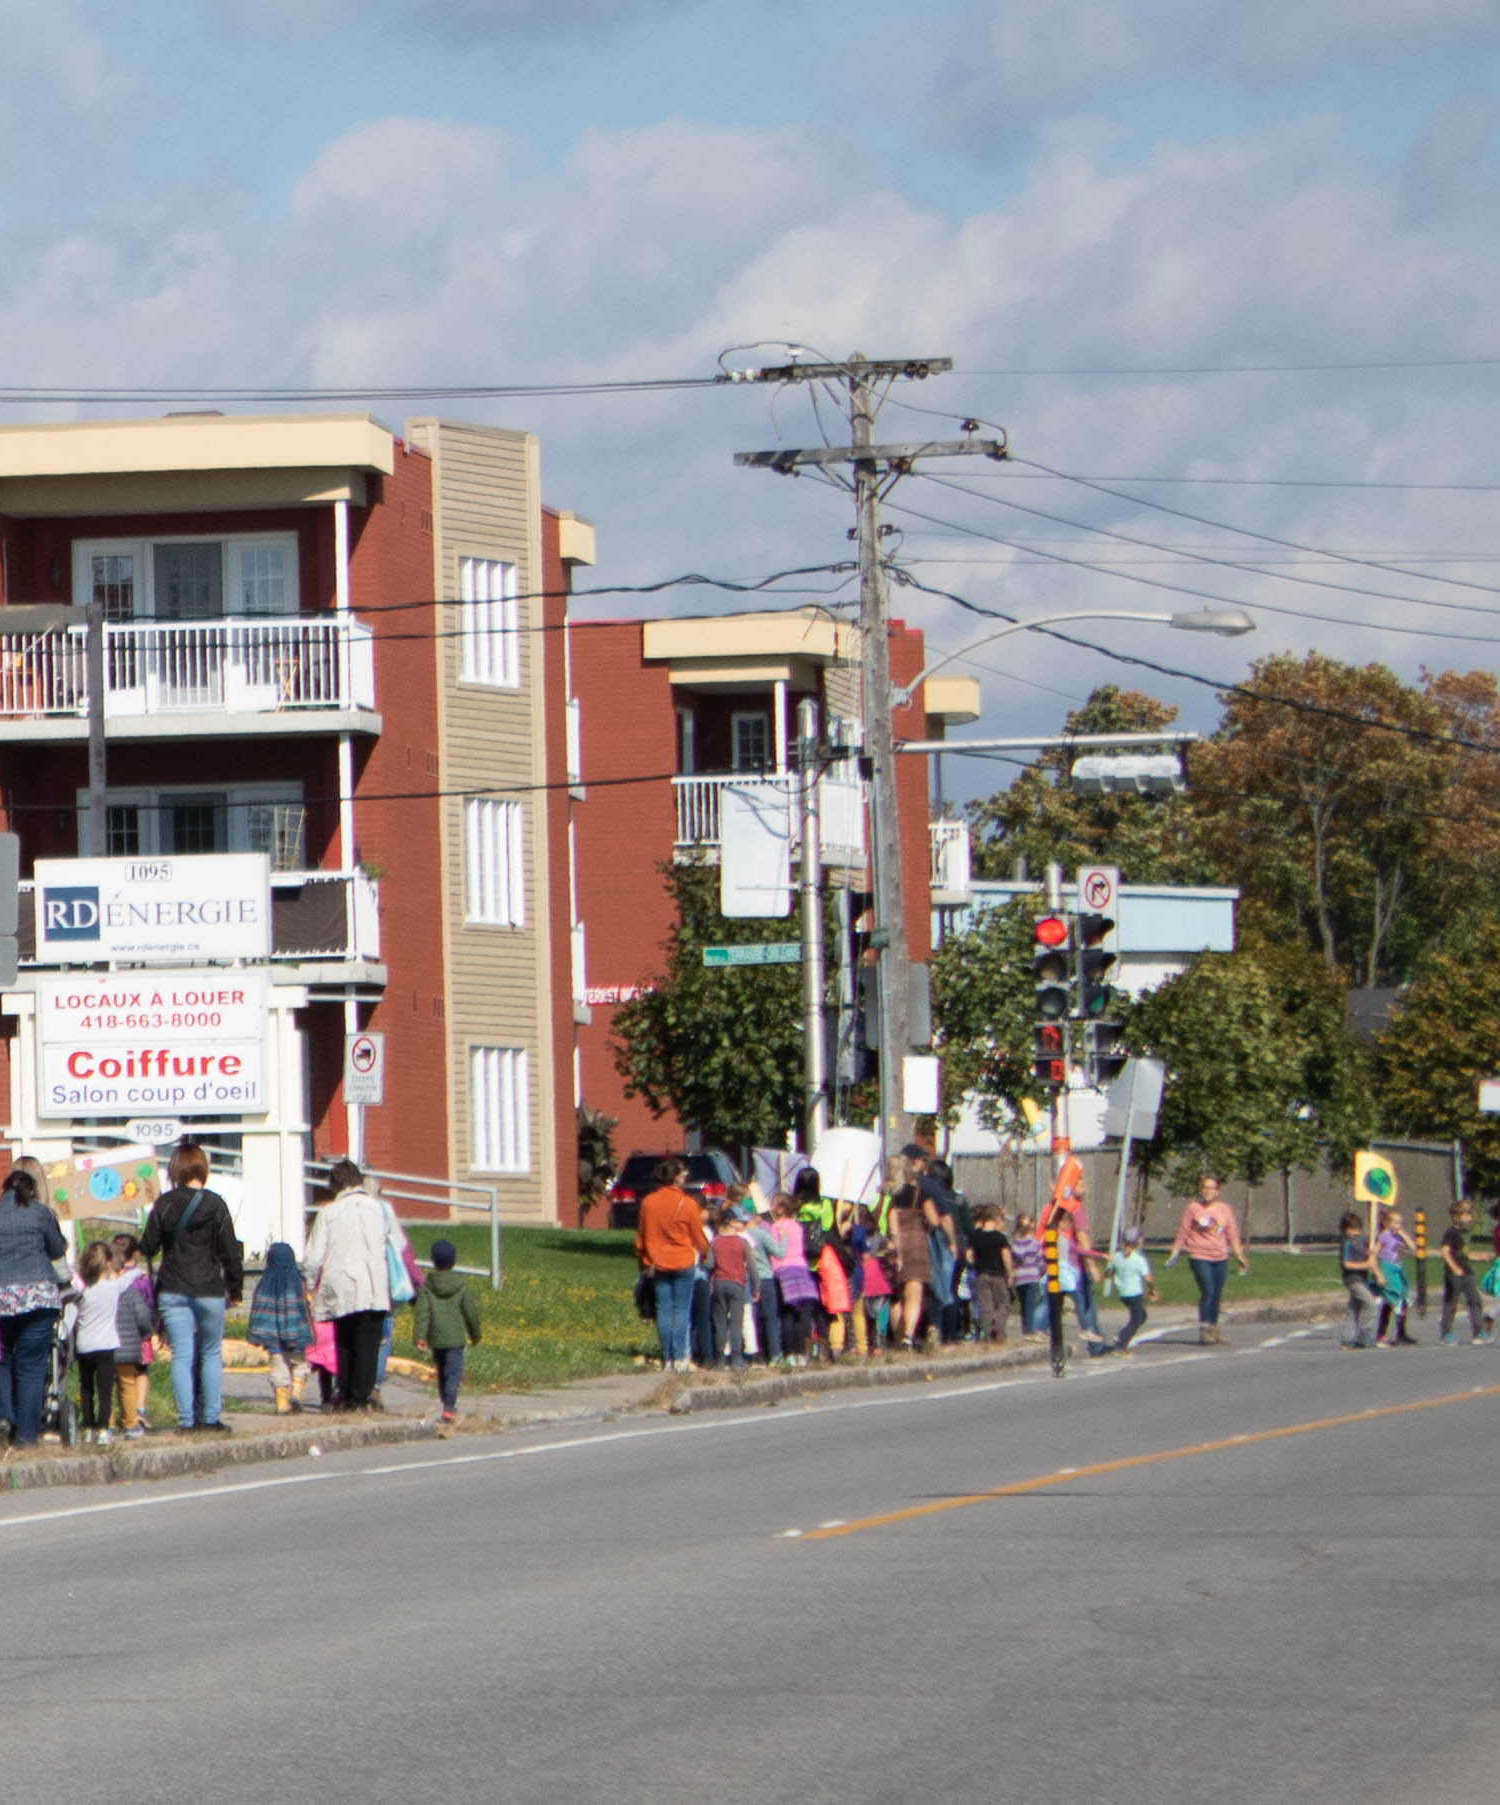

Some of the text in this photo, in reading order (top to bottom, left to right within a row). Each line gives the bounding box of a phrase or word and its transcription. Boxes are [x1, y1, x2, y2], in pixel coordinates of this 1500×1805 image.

[130, 864, 169, 881] 1095
[54, 993, 142, 1009] LOCAUX
[172, 990, 245, 1006] LOUER
[80, 1012, 222, 1029] 418-663-8000
[66, 1049, 242, 1080] Coiffure
[52, 1081, 257, 1105] Salon coup d'oeil
[134, 1123, 173, 1137] 1095
